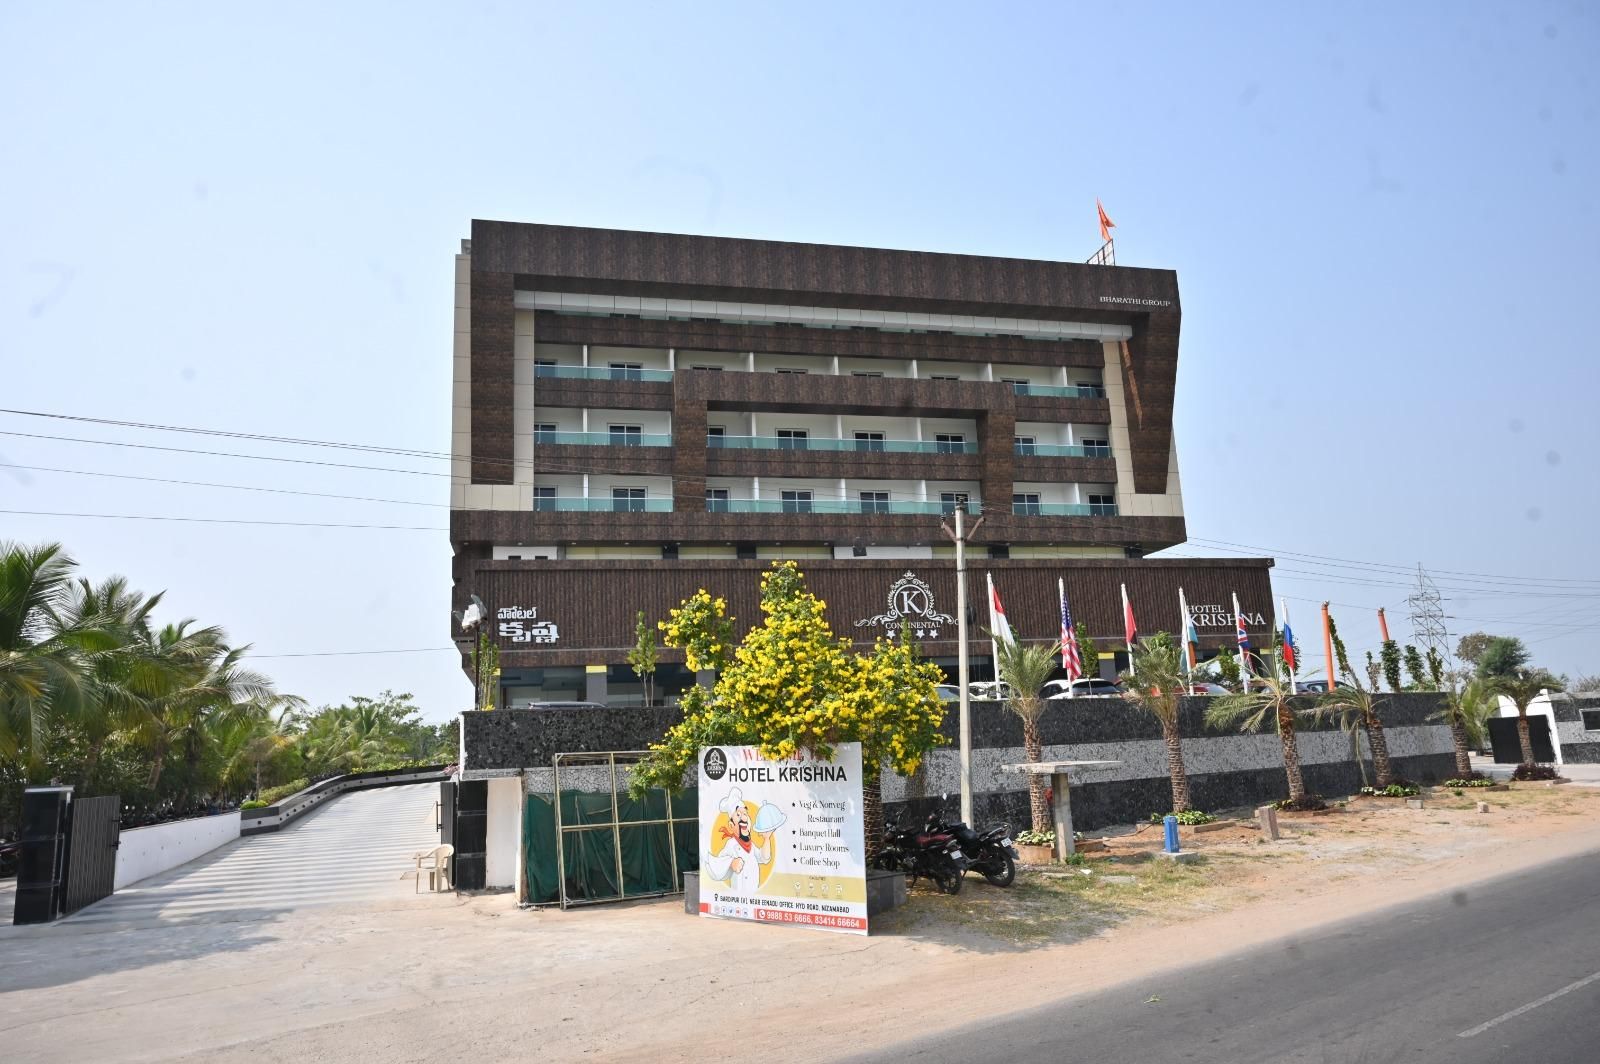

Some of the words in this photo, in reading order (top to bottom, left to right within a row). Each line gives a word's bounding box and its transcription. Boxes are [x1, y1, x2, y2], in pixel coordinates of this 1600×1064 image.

[1100, 296, 1141, 304] BHARATHI
[900, 590, 922, 614] K
[1186, 604, 1225, 613] HOTEL
[885, 621, 940, 629] CONINENTAL
[499, 621, 560, 643] కృష్ణ
[729, 768, 775, 782] HOTEL
[779, 766, 847, 782] KRISHNA
[807, 814, 845, 823] Restaurant
[799, 827, 827, 839] Banquet
[827, 828, 841, 838] Hall
[799, 842, 823, 854] Luxury
[825, 843, 850, 853] Rooms
[800, 857, 822, 866] Coffee
[822, 857, 841, 870] Shop
[821, 904, 850, 914] NIZAMABAD
[766, 910, 783, 920] 9888
[784, 912, 793, 922] 53
[814, 915, 835, 926] 83414
[837, 917, 860, 928] 66664
